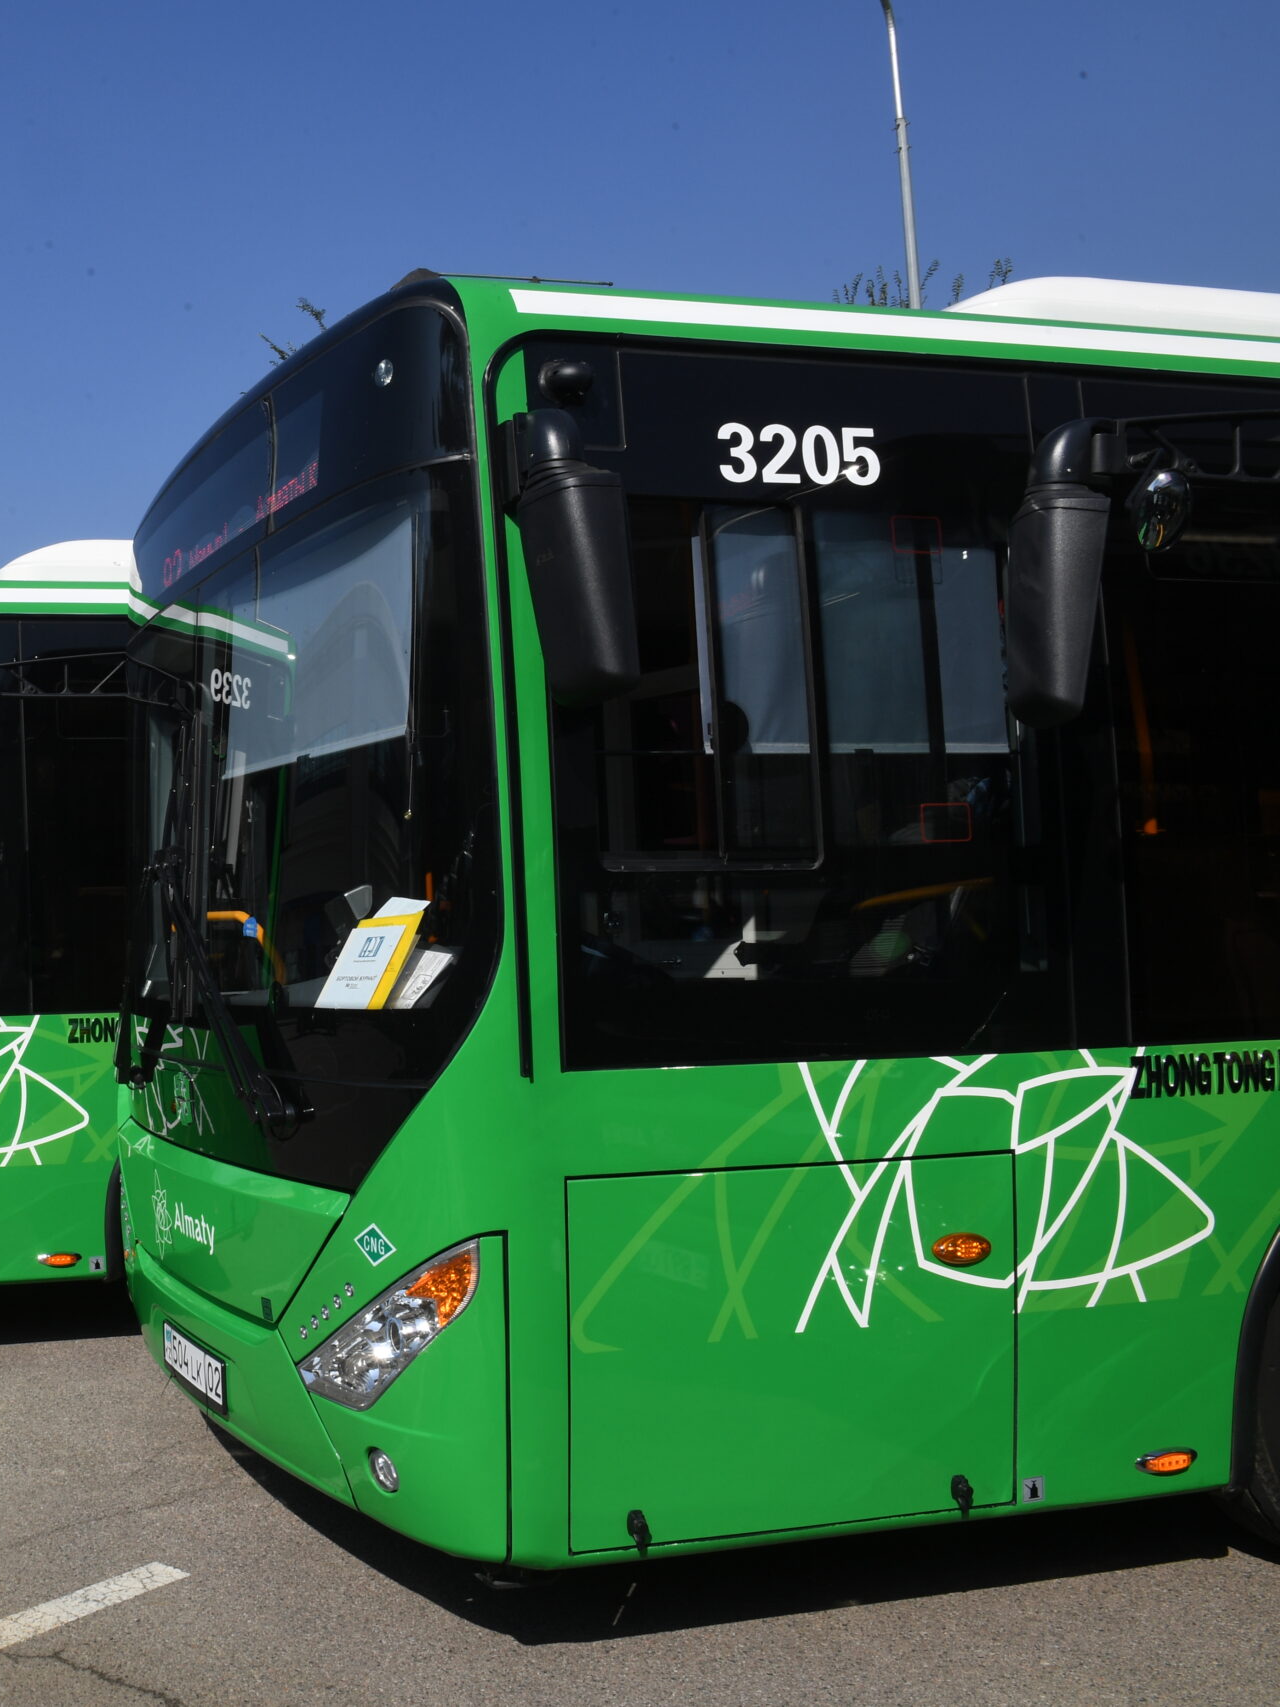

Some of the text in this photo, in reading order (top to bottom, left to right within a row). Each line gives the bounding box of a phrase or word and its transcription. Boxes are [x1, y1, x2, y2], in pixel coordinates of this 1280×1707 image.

[717, 422, 881, 487] 3205
[67, 1017, 119, 1043] ZHON
[174, 1203, 215, 1255] Almaty
[362, 1235, 385, 1256] CNG
[207, 1361, 221, 1399] 02
